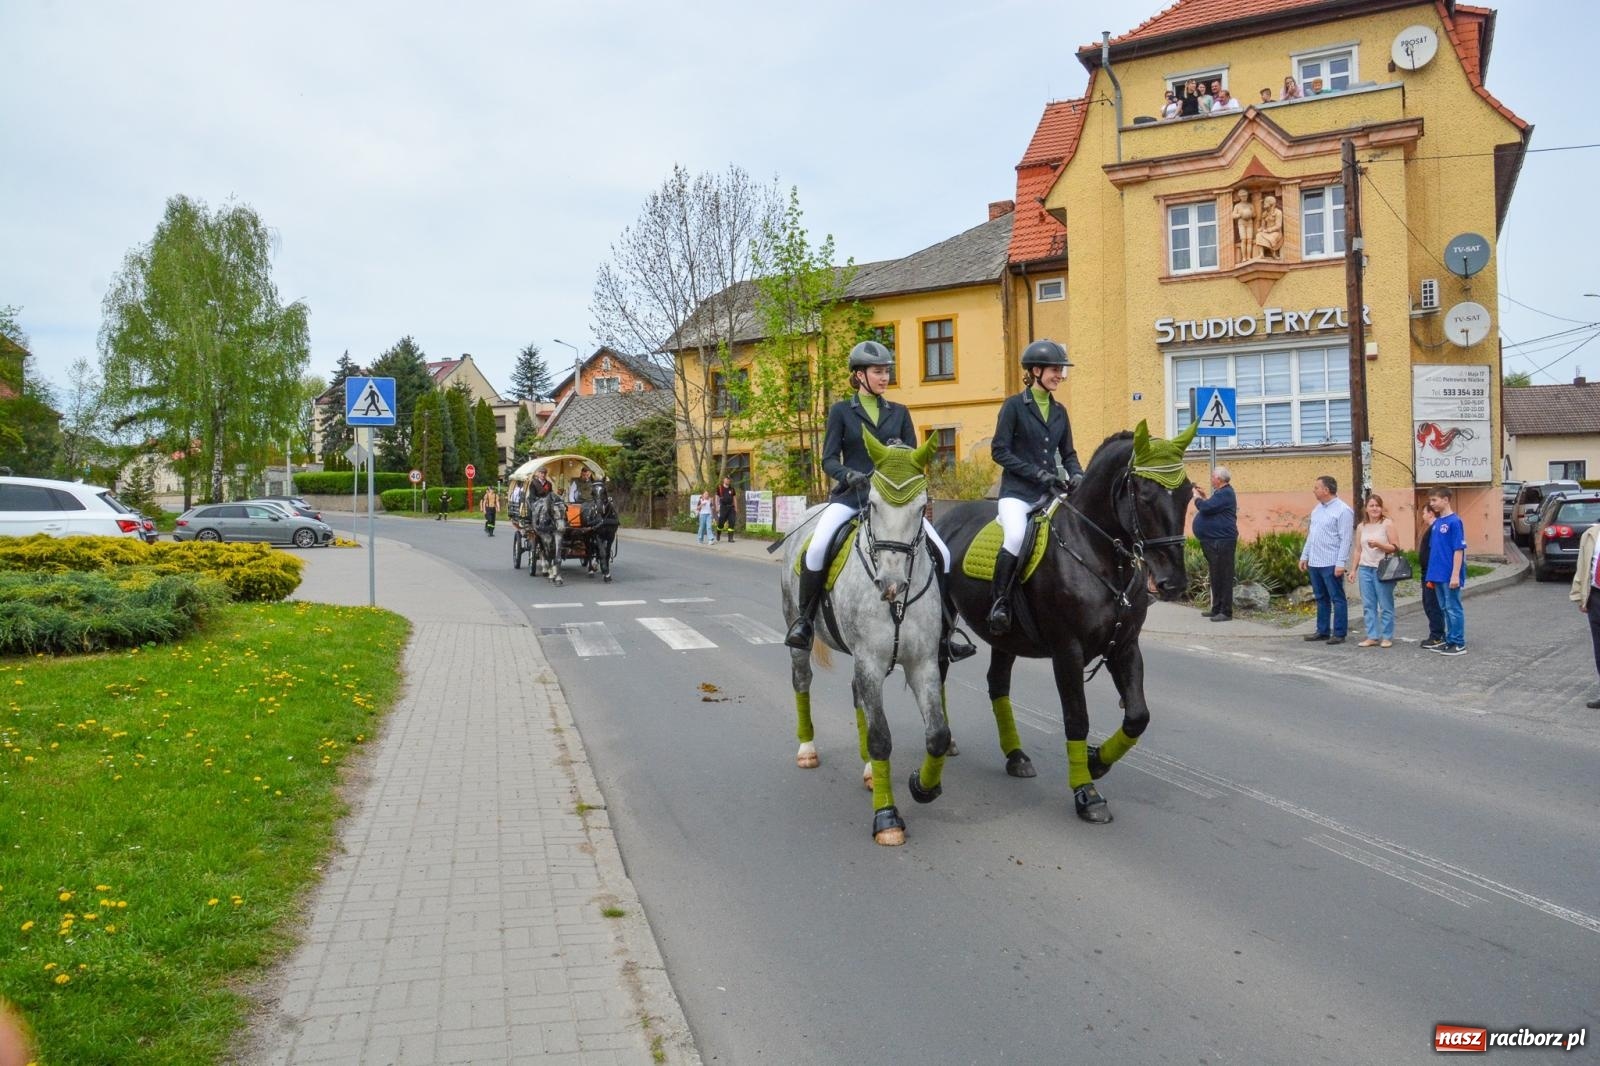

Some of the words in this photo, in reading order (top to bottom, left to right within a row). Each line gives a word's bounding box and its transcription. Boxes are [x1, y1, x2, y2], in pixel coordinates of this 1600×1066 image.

[1400, 36, 1427, 46] PROSAT
[1453, 245, 1481, 253] TV-SAT
[1454, 314, 1480, 323] TV-SAT
[1155, 315, 1257, 344] STUDIO
[1443, 388, 1456, 396] 533
[1457, 388, 1471, 396] 354
[1472, 388, 1485, 396] 333
[1418, 456, 1451, 467] STUDIO
[1455, 455, 1488, 466] FRYZUR
[1435, 470, 1473, 478] SOLARIUM
